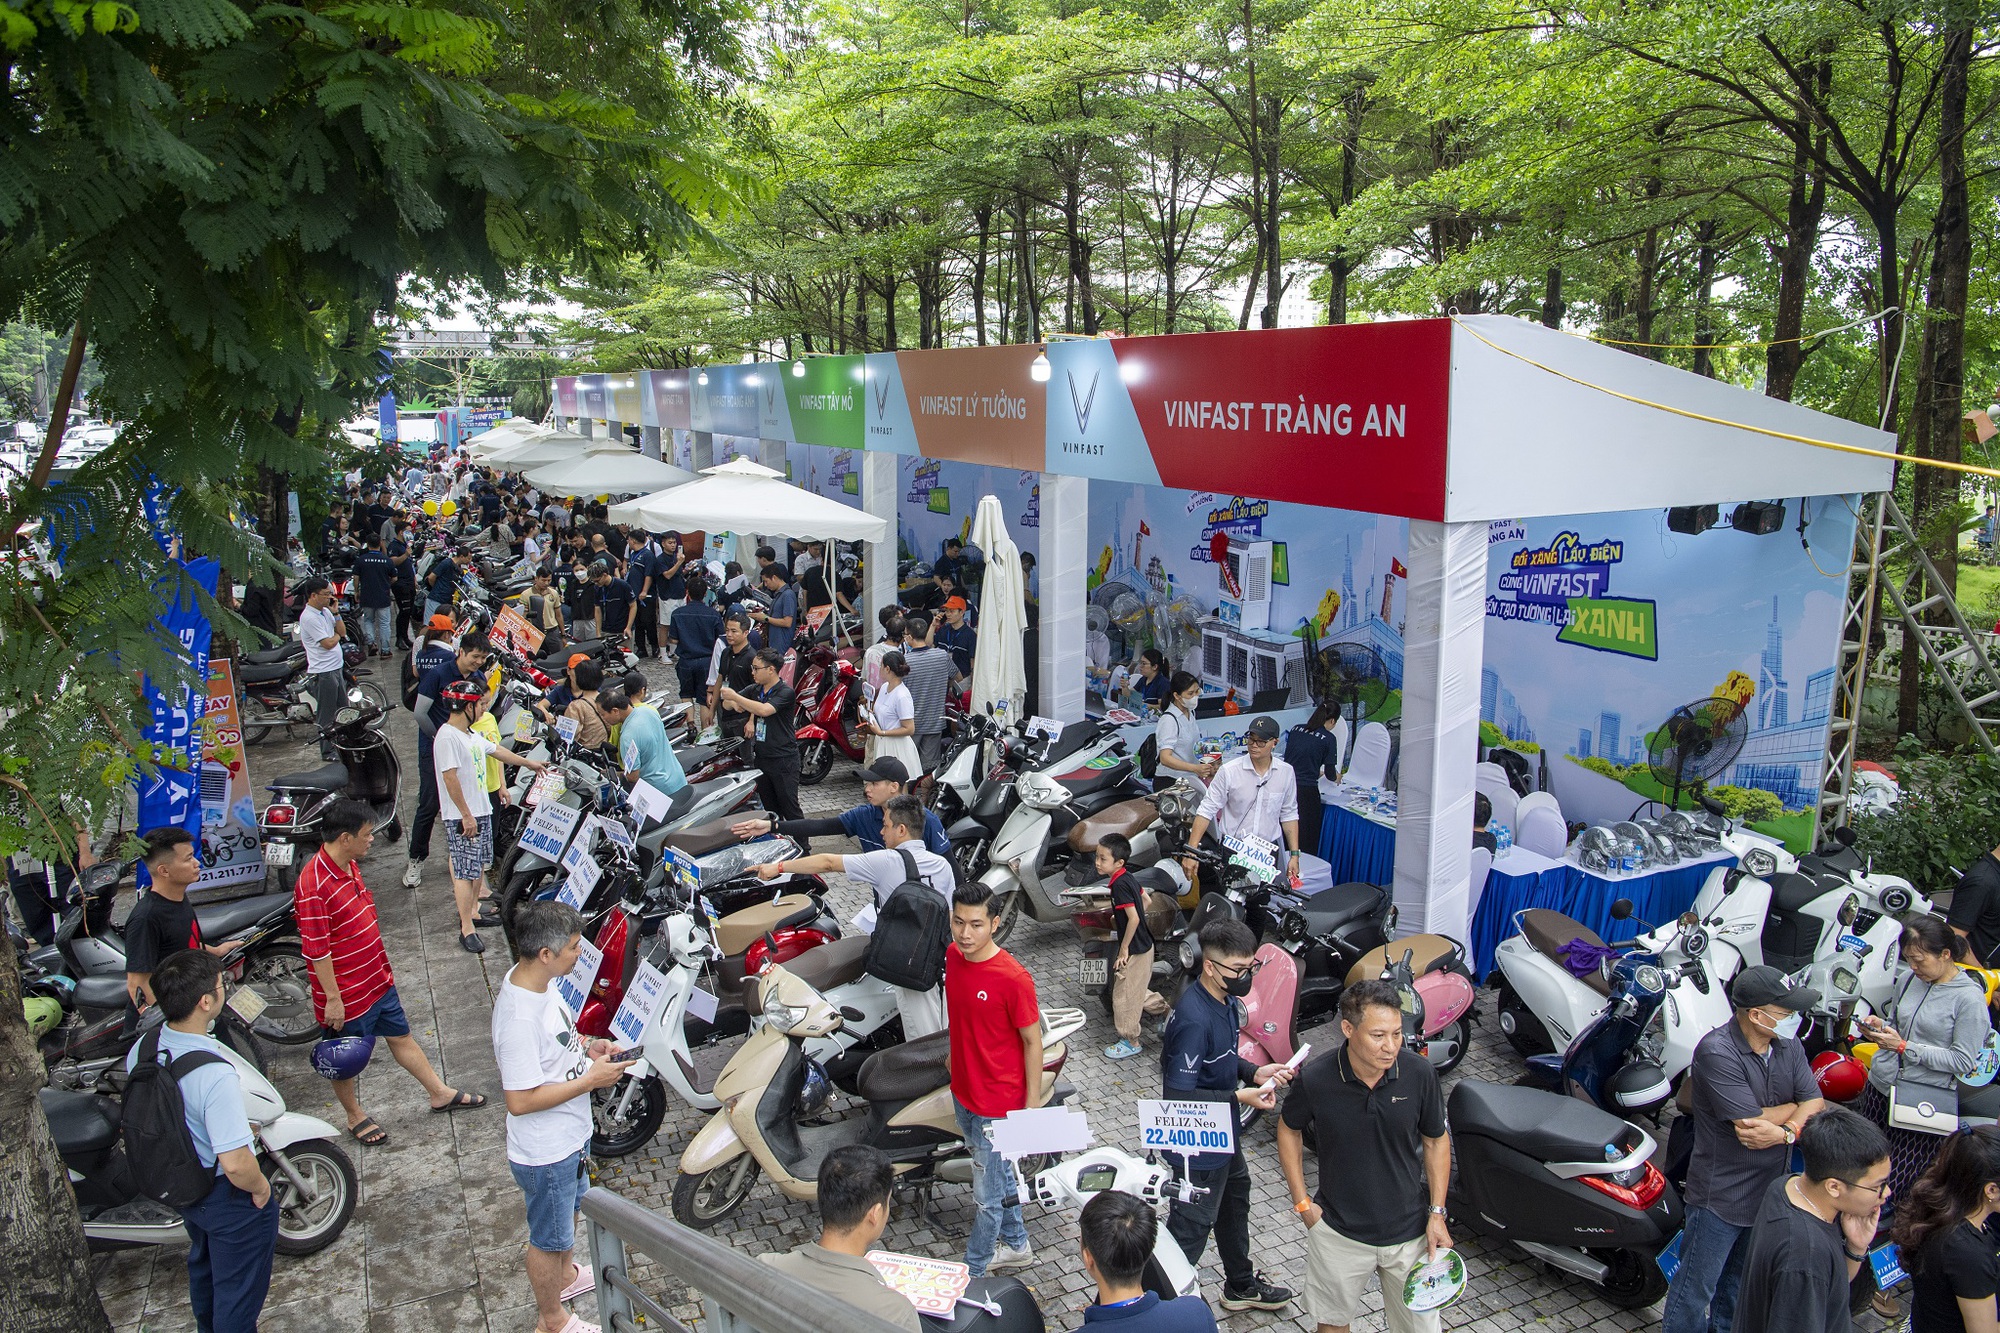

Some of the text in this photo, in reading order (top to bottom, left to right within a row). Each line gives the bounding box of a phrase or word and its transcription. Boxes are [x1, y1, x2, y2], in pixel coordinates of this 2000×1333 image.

[467, 396, 513, 404] VINFAST
[800, 387, 853, 412] VINFAST TÂY MỖ
[920, 389, 1027, 420] VINFAST LÝ TƯỞNG
[1164, 394, 1406, 437] VINFAST TRÀNG AN
[870, 426, 893, 435] VINFAST
[1063, 442, 1104, 456] VINFAST
[1494, 520, 1512, 530] FAST
[1508, 528, 1525, 540] AN
[1531, 549, 1558, 565] XĂNG
[1501, 574, 1522, 589] CÙNG
[1499, 602, 1515, 619] TẠO
[1518, 602, 1551, 621] TƯƠNG
[1572, 606, 1646, 645] XANH
[550, 806, 574, 819] VINFAST
[533, 816, 565, 836] FELIZ Neo
[521, 827, 563, 856] 22.400.000
[1223, 835, 1244, 852] THU
[1252, 836, 1277, 850] VINFAST
[92, 959, 117, 968] HONDA
[644, 972, 662, 990] VINFAST
[1080, 971, 1106, 983] 370.20
[1154, 1116, 1217, 1129] FELIZ Neo
[1145, 1128, 1229, 1148] 22.400.000
[886, 1257, 919, 1266] VINFAST
[904, 1269, 933, 1283] XE
[904, 1282, 957, 1298] CAO
